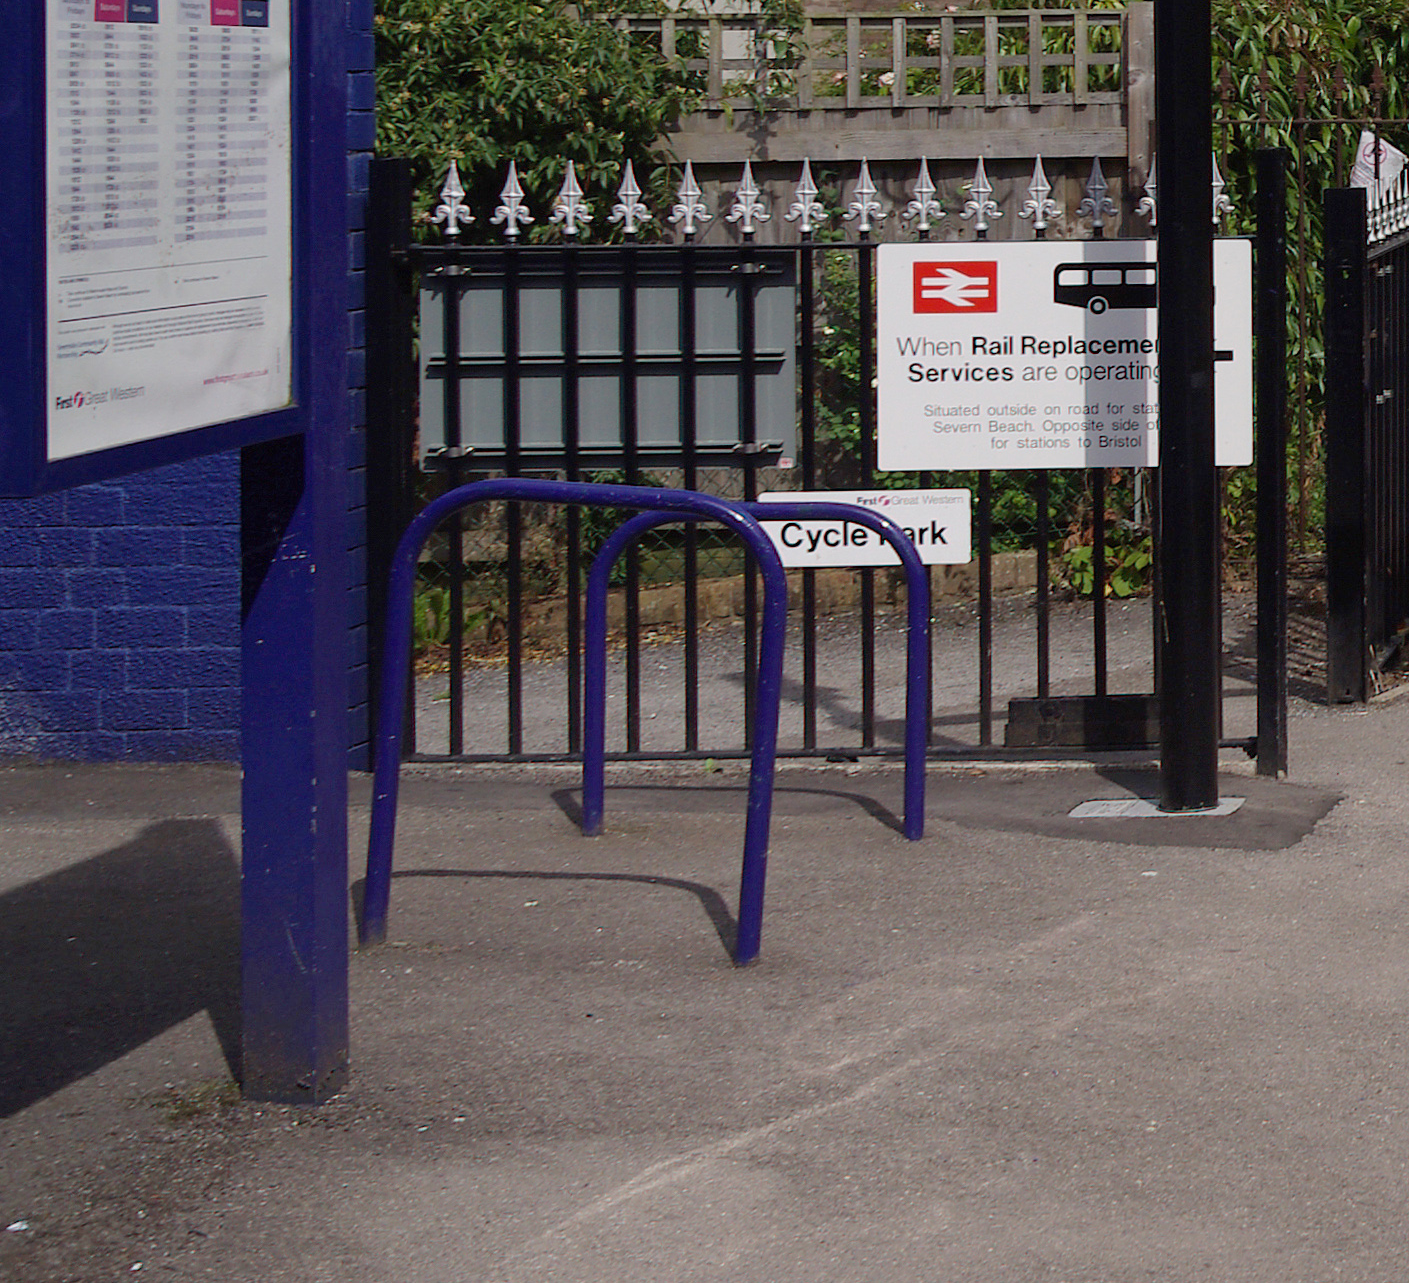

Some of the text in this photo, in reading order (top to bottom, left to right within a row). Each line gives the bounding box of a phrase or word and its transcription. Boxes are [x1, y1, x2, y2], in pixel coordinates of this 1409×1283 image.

[896, 336, 962, 356] When
[971, 336, 1013, 355] Rail
[907, 362, 1014, 382] Services
[1022, 364, 1058, 381] are
[924, 403, 980, 417] Situated
[986, 403, 1036, 416] outside
[1043, 405, 1061, 415] on
[1067, 403, 1099, 415] road
[1106, 402, 1125, 415] for
[933, 421, 981, 434] Severn
[988, 420, 1035, 432] Beach.
[1042, 420, 1105, 434] Opposite
[1111, 419, 1139, 431] side
[990, 434, 1142, 449] for stations to Bristol
[892, 495, 919, 506] Great
[922, 494, 964, 505] Western
[780, 520, 947, 553] Cycle ark
